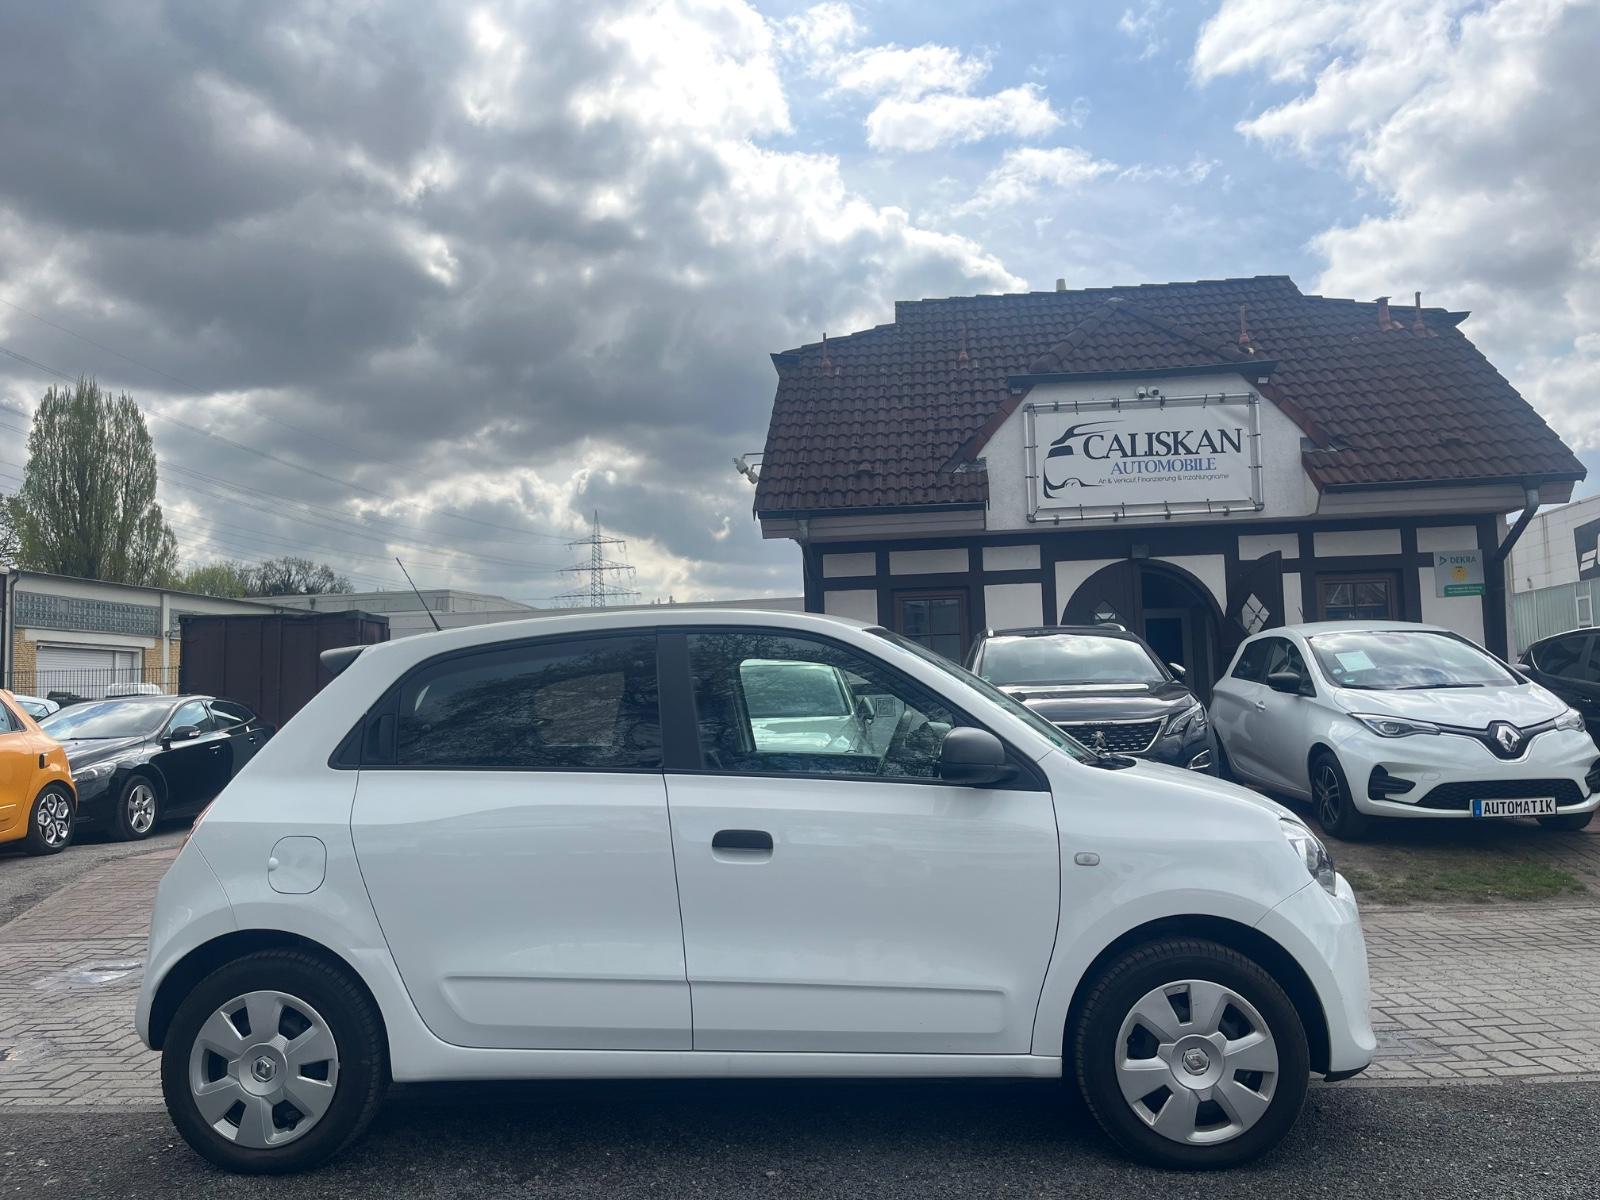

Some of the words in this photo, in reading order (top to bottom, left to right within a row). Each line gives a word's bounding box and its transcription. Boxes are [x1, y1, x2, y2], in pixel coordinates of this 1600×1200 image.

[1083, 428, 1242, 460] CALISKAN
[1111, 457, 1217, 475] AUTOMOBILE
[1450, 556, 1477, 564] DEKRA
[1483, 800, 1553, 815] AUTOMATIK
